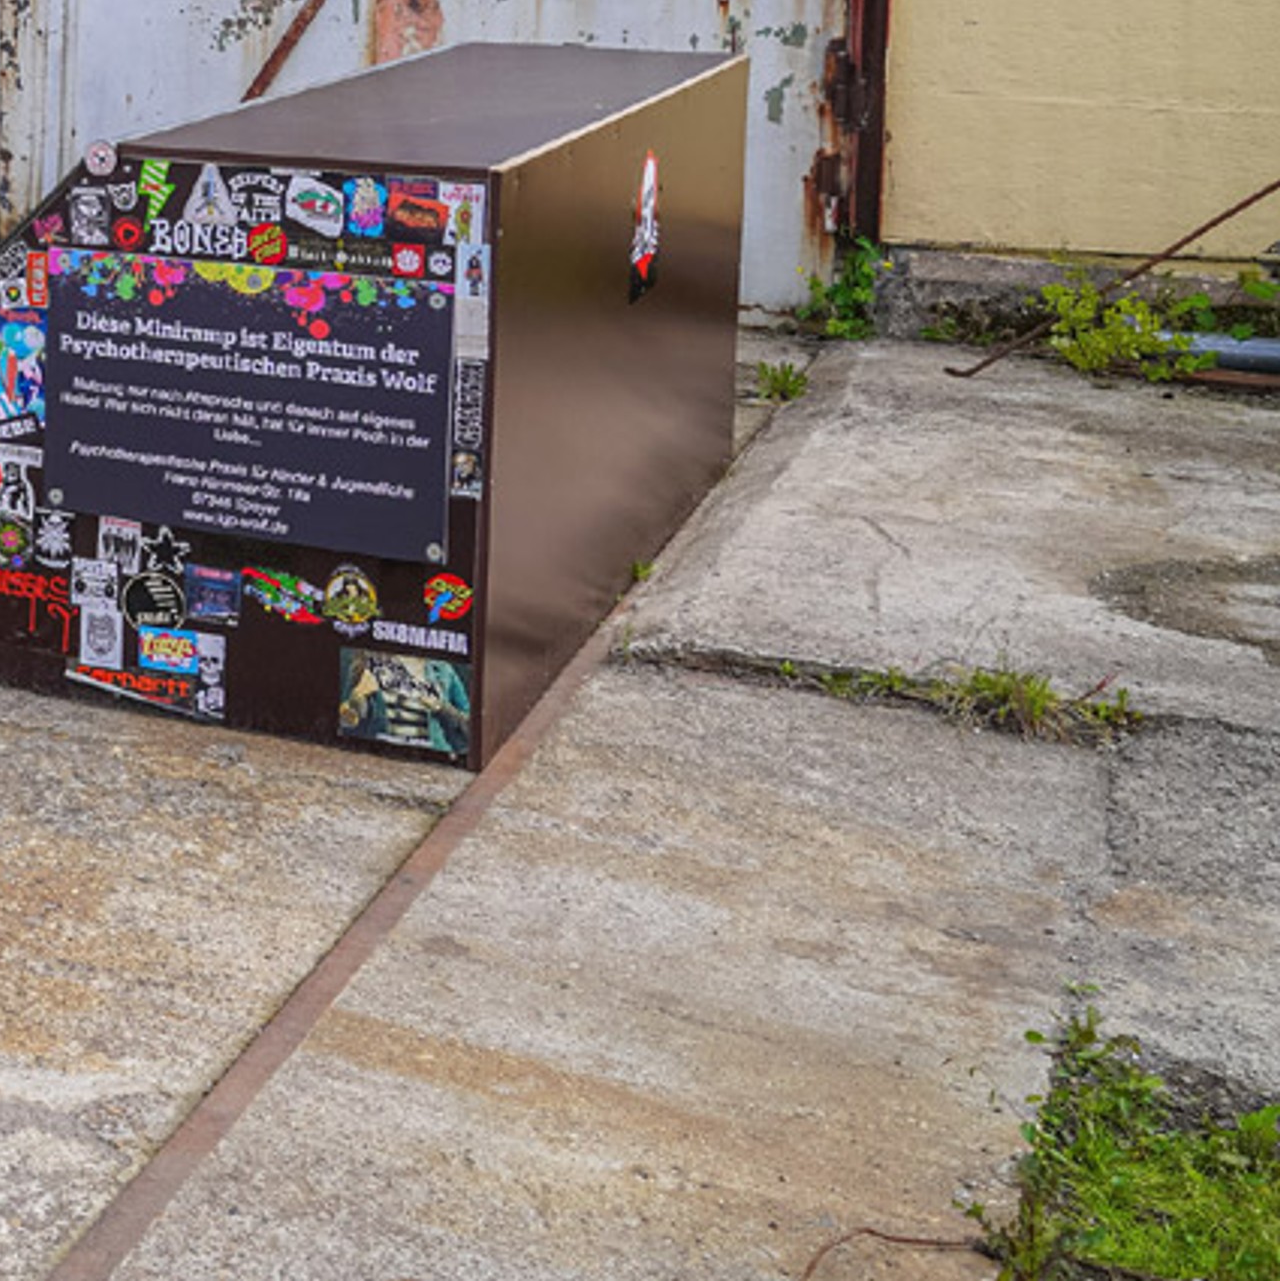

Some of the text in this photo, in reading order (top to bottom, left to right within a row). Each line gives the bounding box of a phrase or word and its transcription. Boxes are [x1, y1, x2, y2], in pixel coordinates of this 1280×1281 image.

[149, 219, 247, 260] BONES
[76, 311, 420, 366] Diese Miniramp ist Eigentum der
[59, 333, 439, 394] Psychotherapeutischen Praxis Wolf
[406, 433, 431, 449] der
